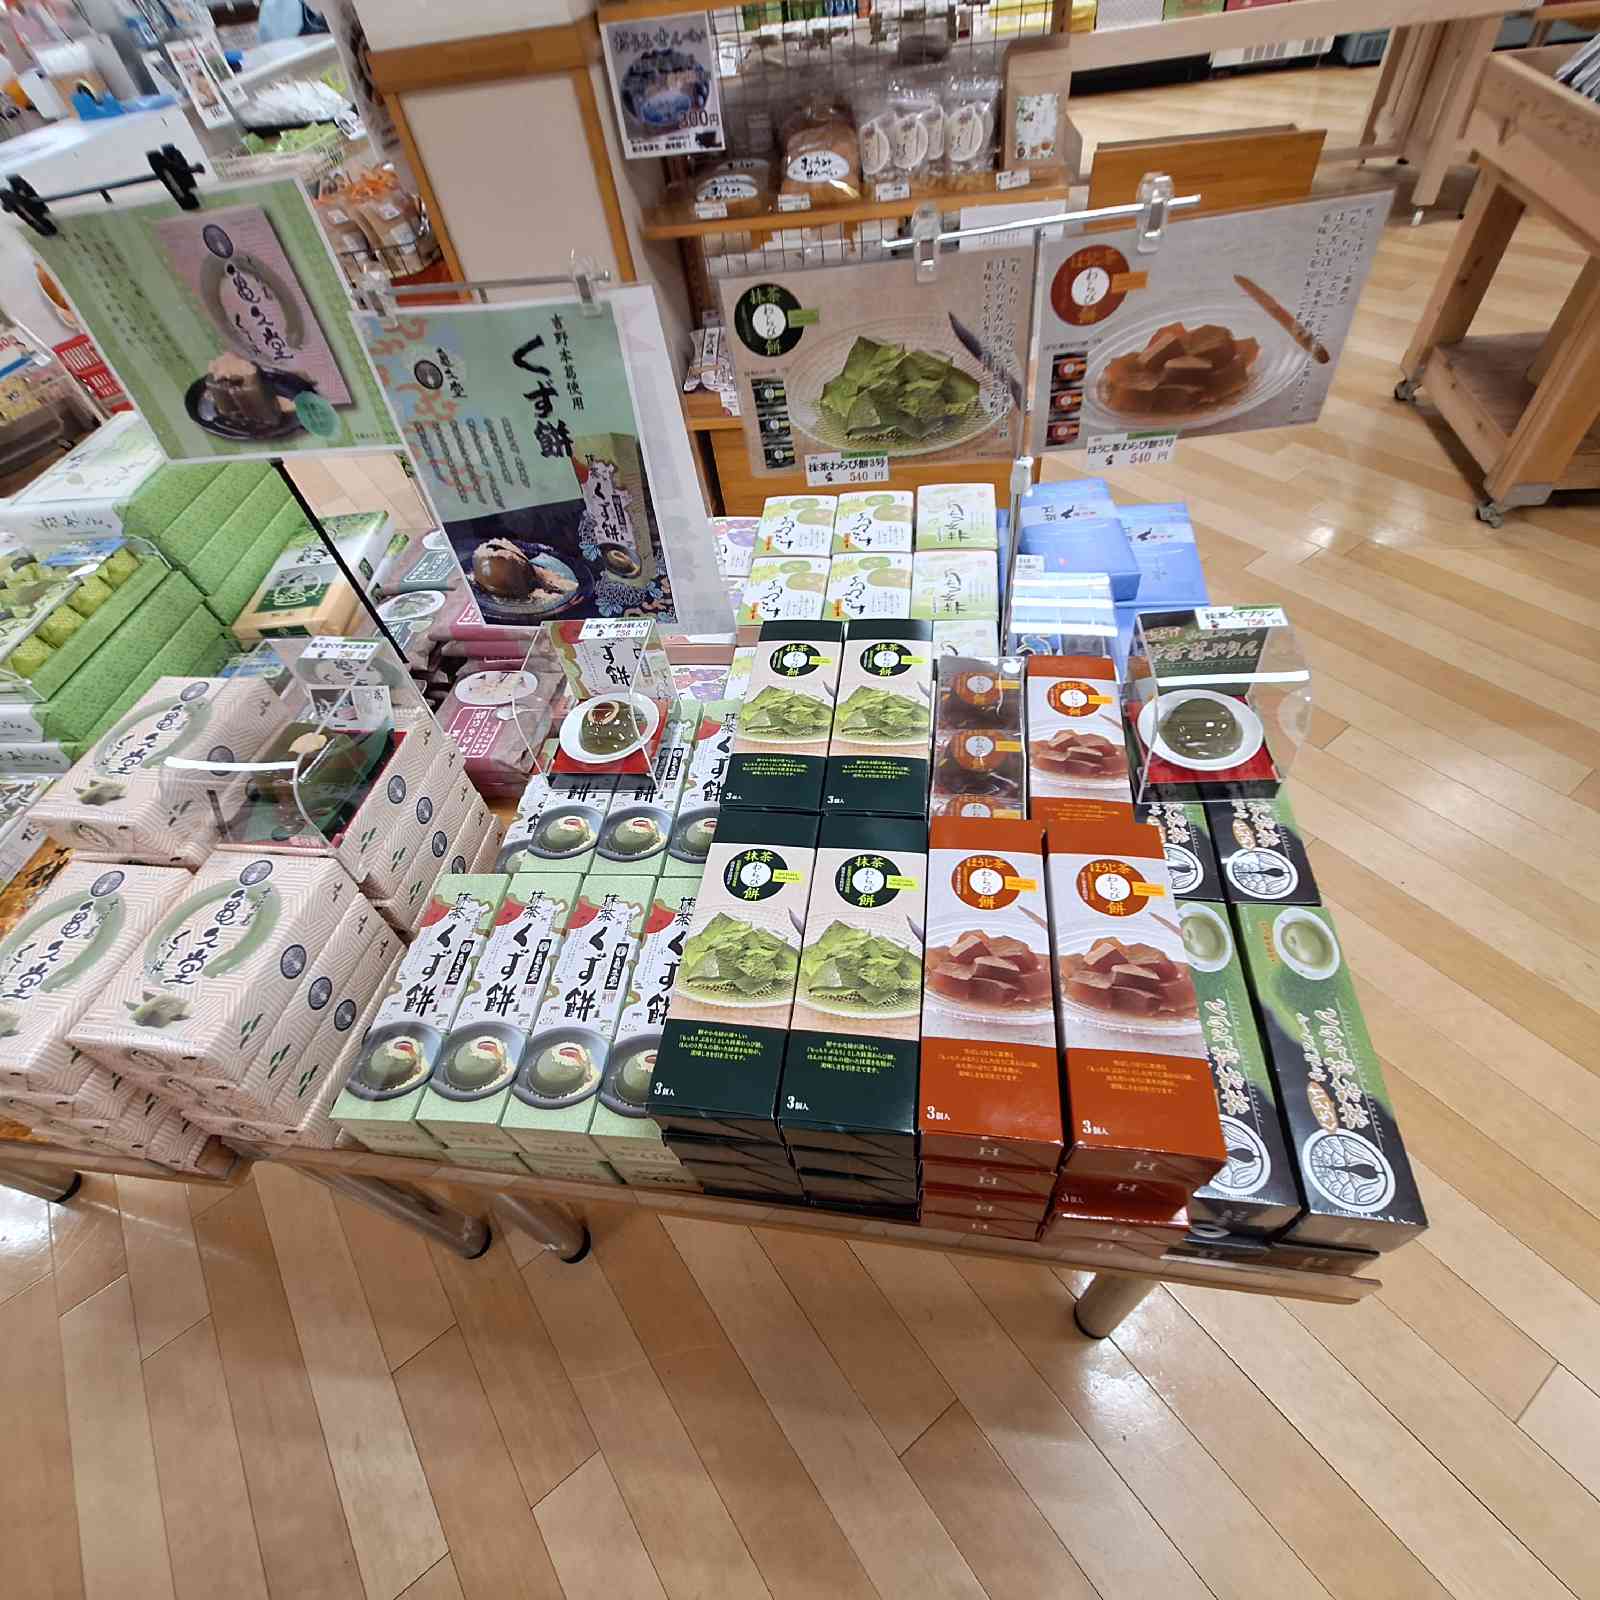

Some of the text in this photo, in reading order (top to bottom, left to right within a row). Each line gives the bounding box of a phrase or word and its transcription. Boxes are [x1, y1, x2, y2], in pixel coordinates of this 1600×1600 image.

[512, 334, 574, 458] くず餅
[744, 850, 773, 862] 抹茶
[855, 856, 884, 868] 抹茶
[966, 858, 1005, 873] ほうじ茶
[1089, 863, 1131, 876] ほうじ茶
[743, 889, 760, 900] 餅
[980, 870, 991, 896] わらび
[1106, 875, 1120, 899] わらび
[450, 892, 472, 919] 抹茶
[523, 891, 545, 918] 抹茶
[598, 894, 619, 922] 抹茶
[675, 896, 696, 925] 抹茶
[857, 895, 875, 907] 餅
[1107, 901, 1125, 915] 餅
[404, 924, 457, 1016] くず餅
[478, 923, 534, 1016] くず餅
[564, 926, 609, 1023] くず餅
[647, 930, 687, 1025] くず餅
[927, 1106, 951, 1121] 3個入
[1083, 1119, 1109, 1136] 3個入
